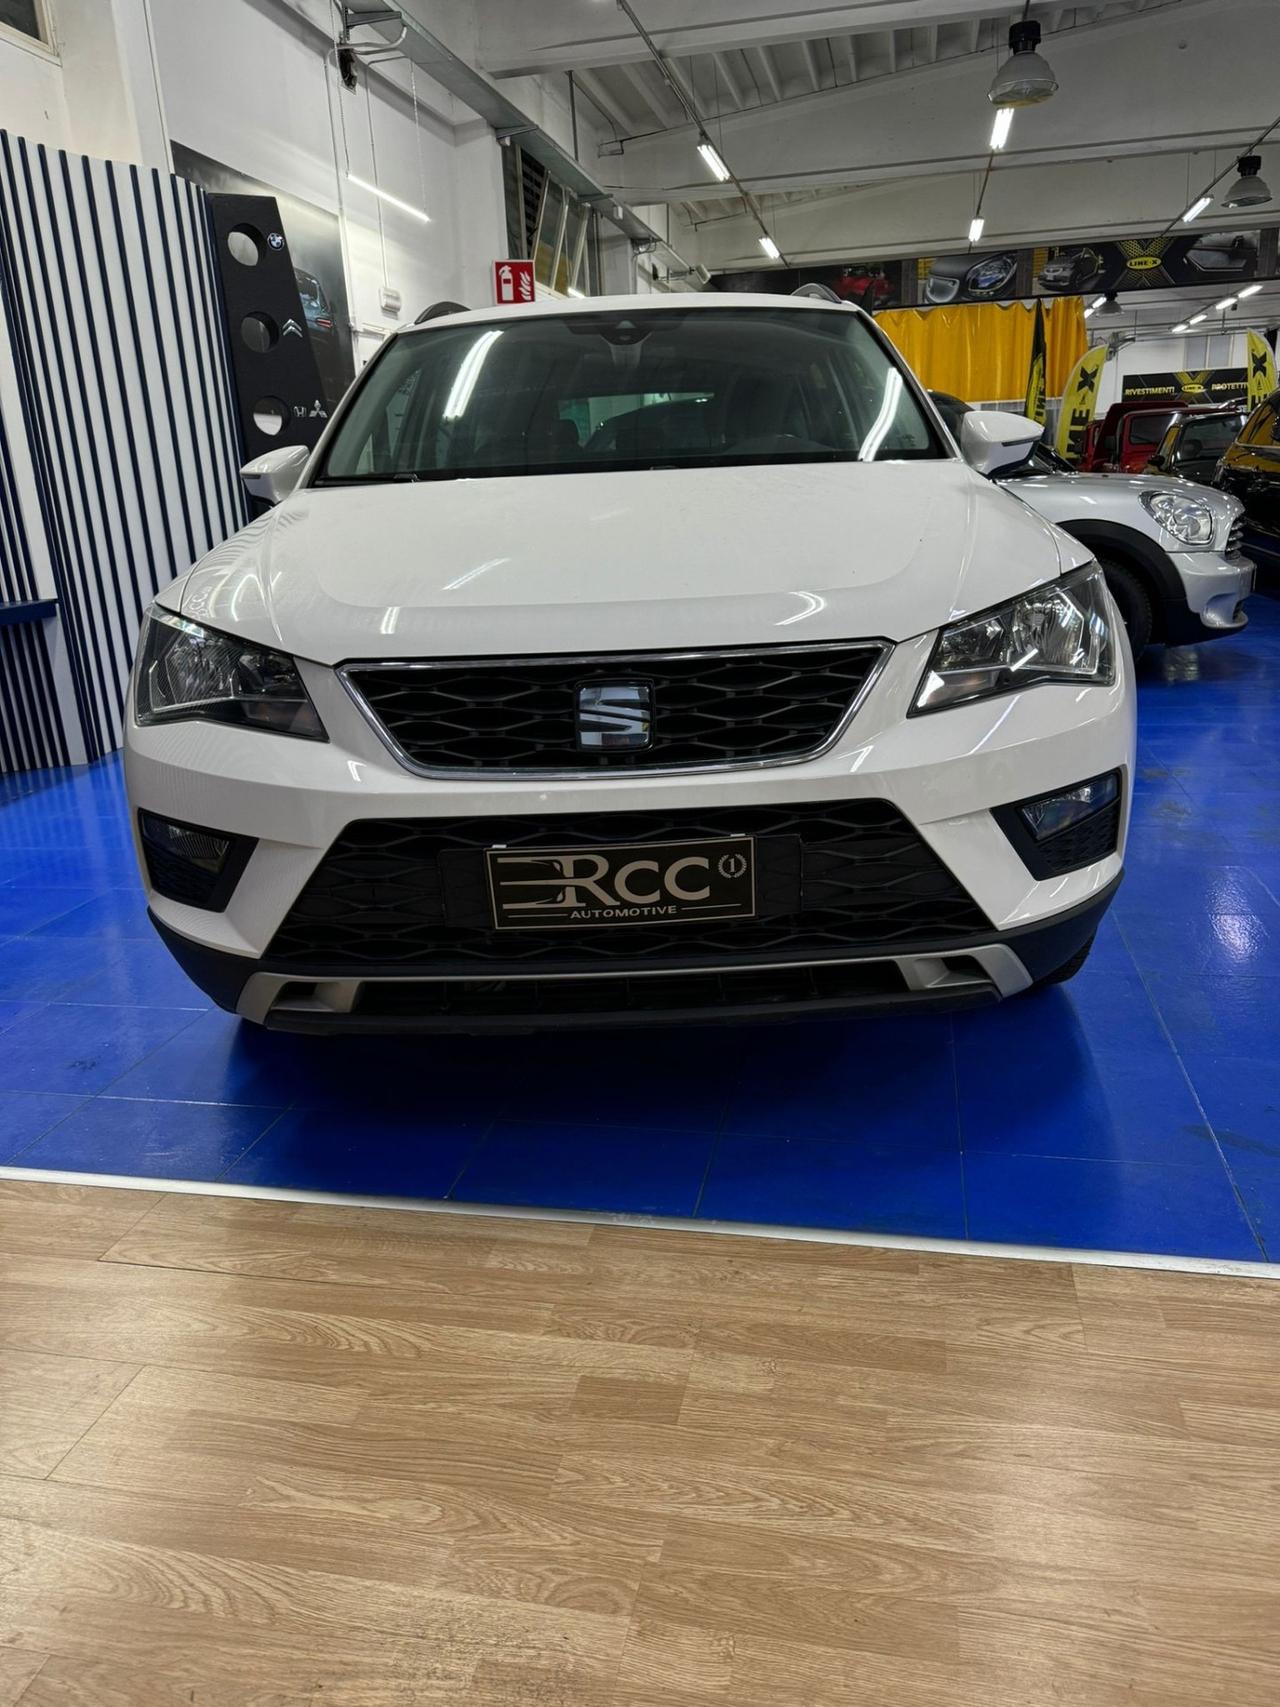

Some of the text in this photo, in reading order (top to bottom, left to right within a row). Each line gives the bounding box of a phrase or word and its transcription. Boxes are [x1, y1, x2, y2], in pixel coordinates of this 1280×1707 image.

[1125, 386, 1175, 395] RIVESTIMENTI
[1212, 381, 1248, 391] PROTETTI
[570, 905, 677, 919] AUTOMOTIVE
